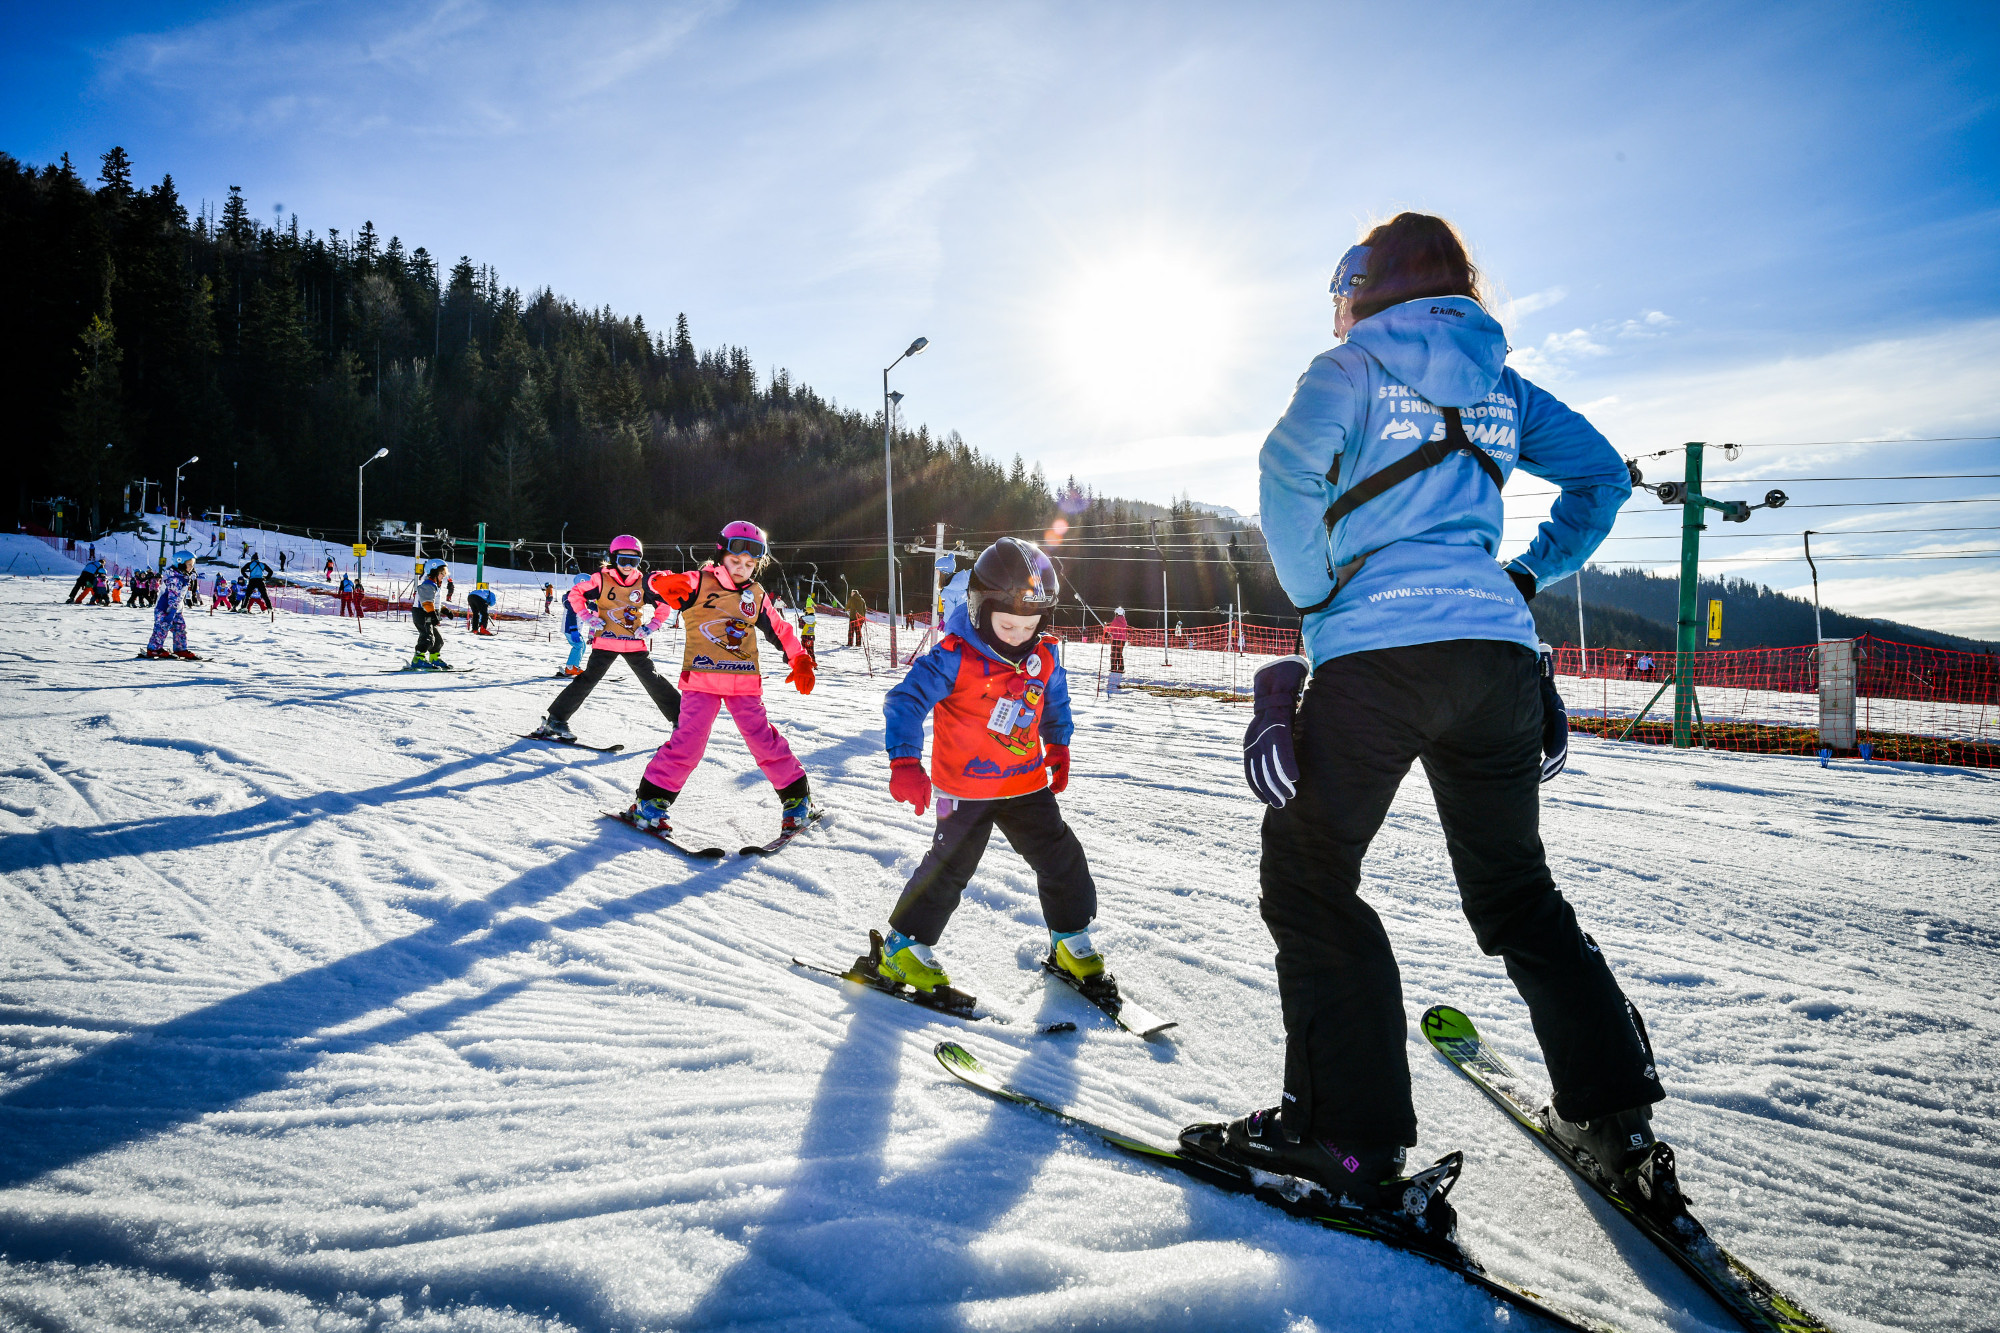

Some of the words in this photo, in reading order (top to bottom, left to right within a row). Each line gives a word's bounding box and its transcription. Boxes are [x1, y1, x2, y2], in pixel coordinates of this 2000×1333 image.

[1378, 385, 1420, 399] SZKO
[1389, 400, 1396, 413] I
[1400, 400, 1514, 421] SNOWARDOWA
[1428, 421, 1516, 449] SRAMA
[607, 586, 616, 601] 6
[702, 592, 720, 608] 2
